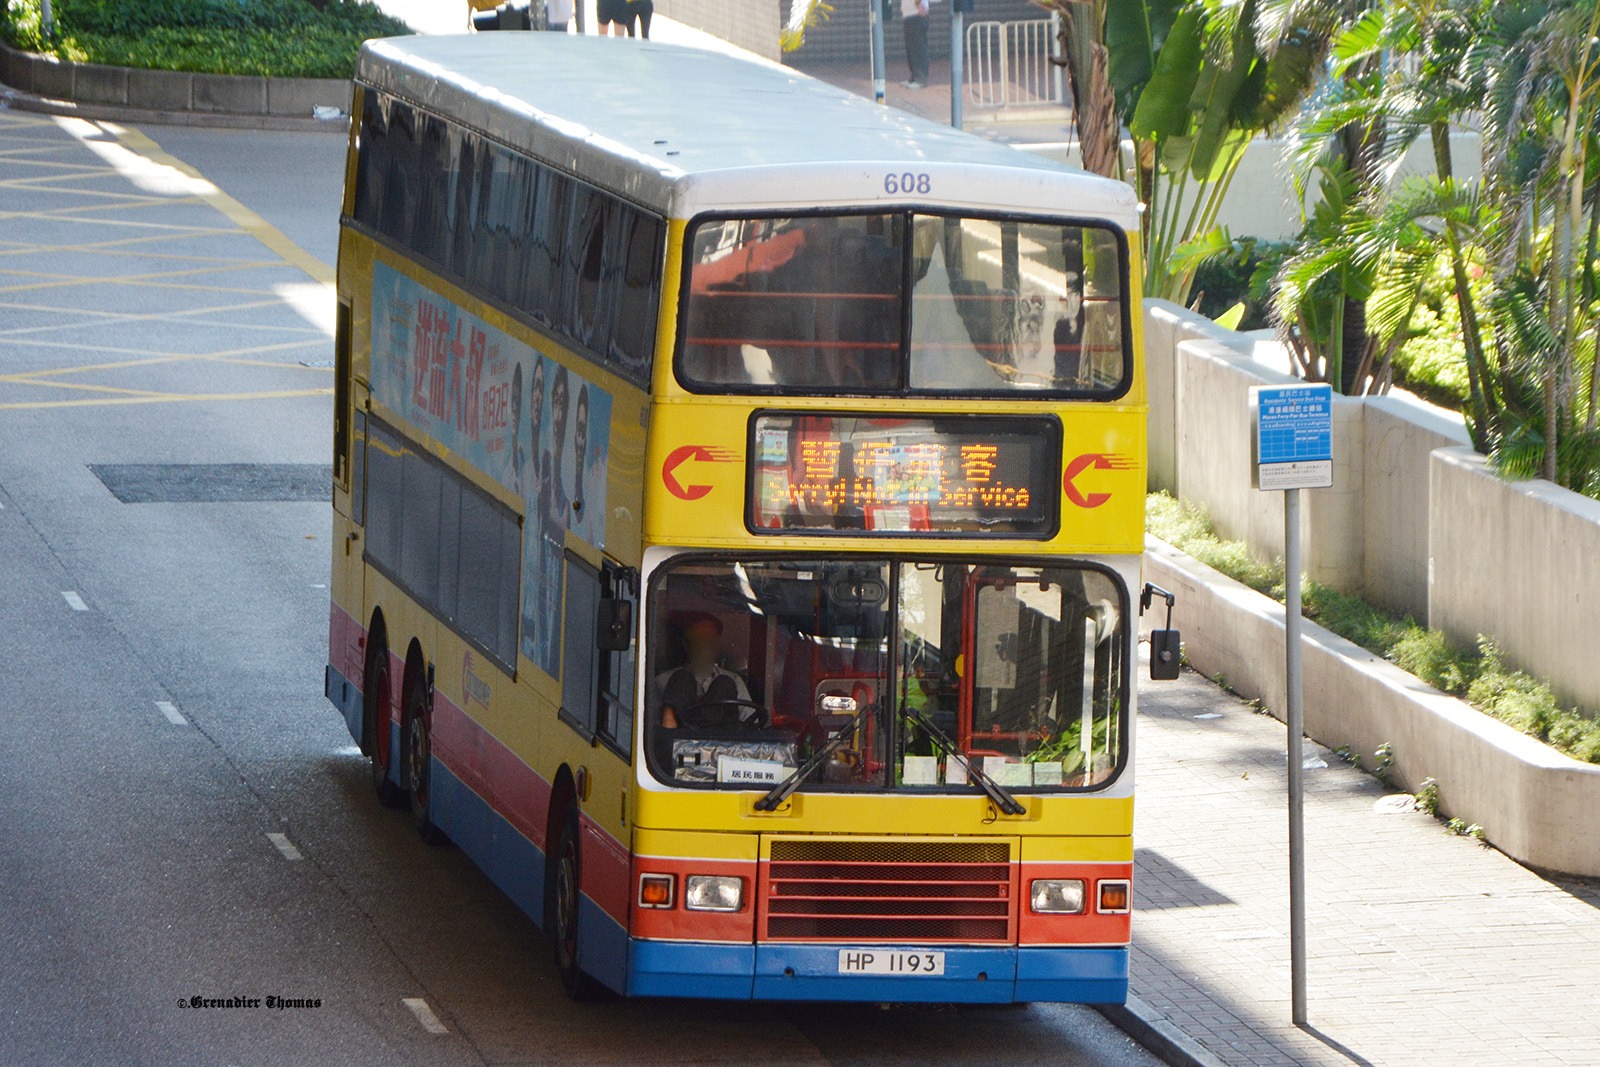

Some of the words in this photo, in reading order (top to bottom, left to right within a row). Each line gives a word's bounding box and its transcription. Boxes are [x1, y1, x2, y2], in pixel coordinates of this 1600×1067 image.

[884, 172, 931, 194] 608
[412, 298, 486, 442] 逆流大叔
[482, 382, 509, 430] 8月2日
[938, 480, 1030, 508] Service
[731, 769, 775, 780] 居民服務
[847, 953, 875, 970] HP
[890, 954, 936, 972] 1193
